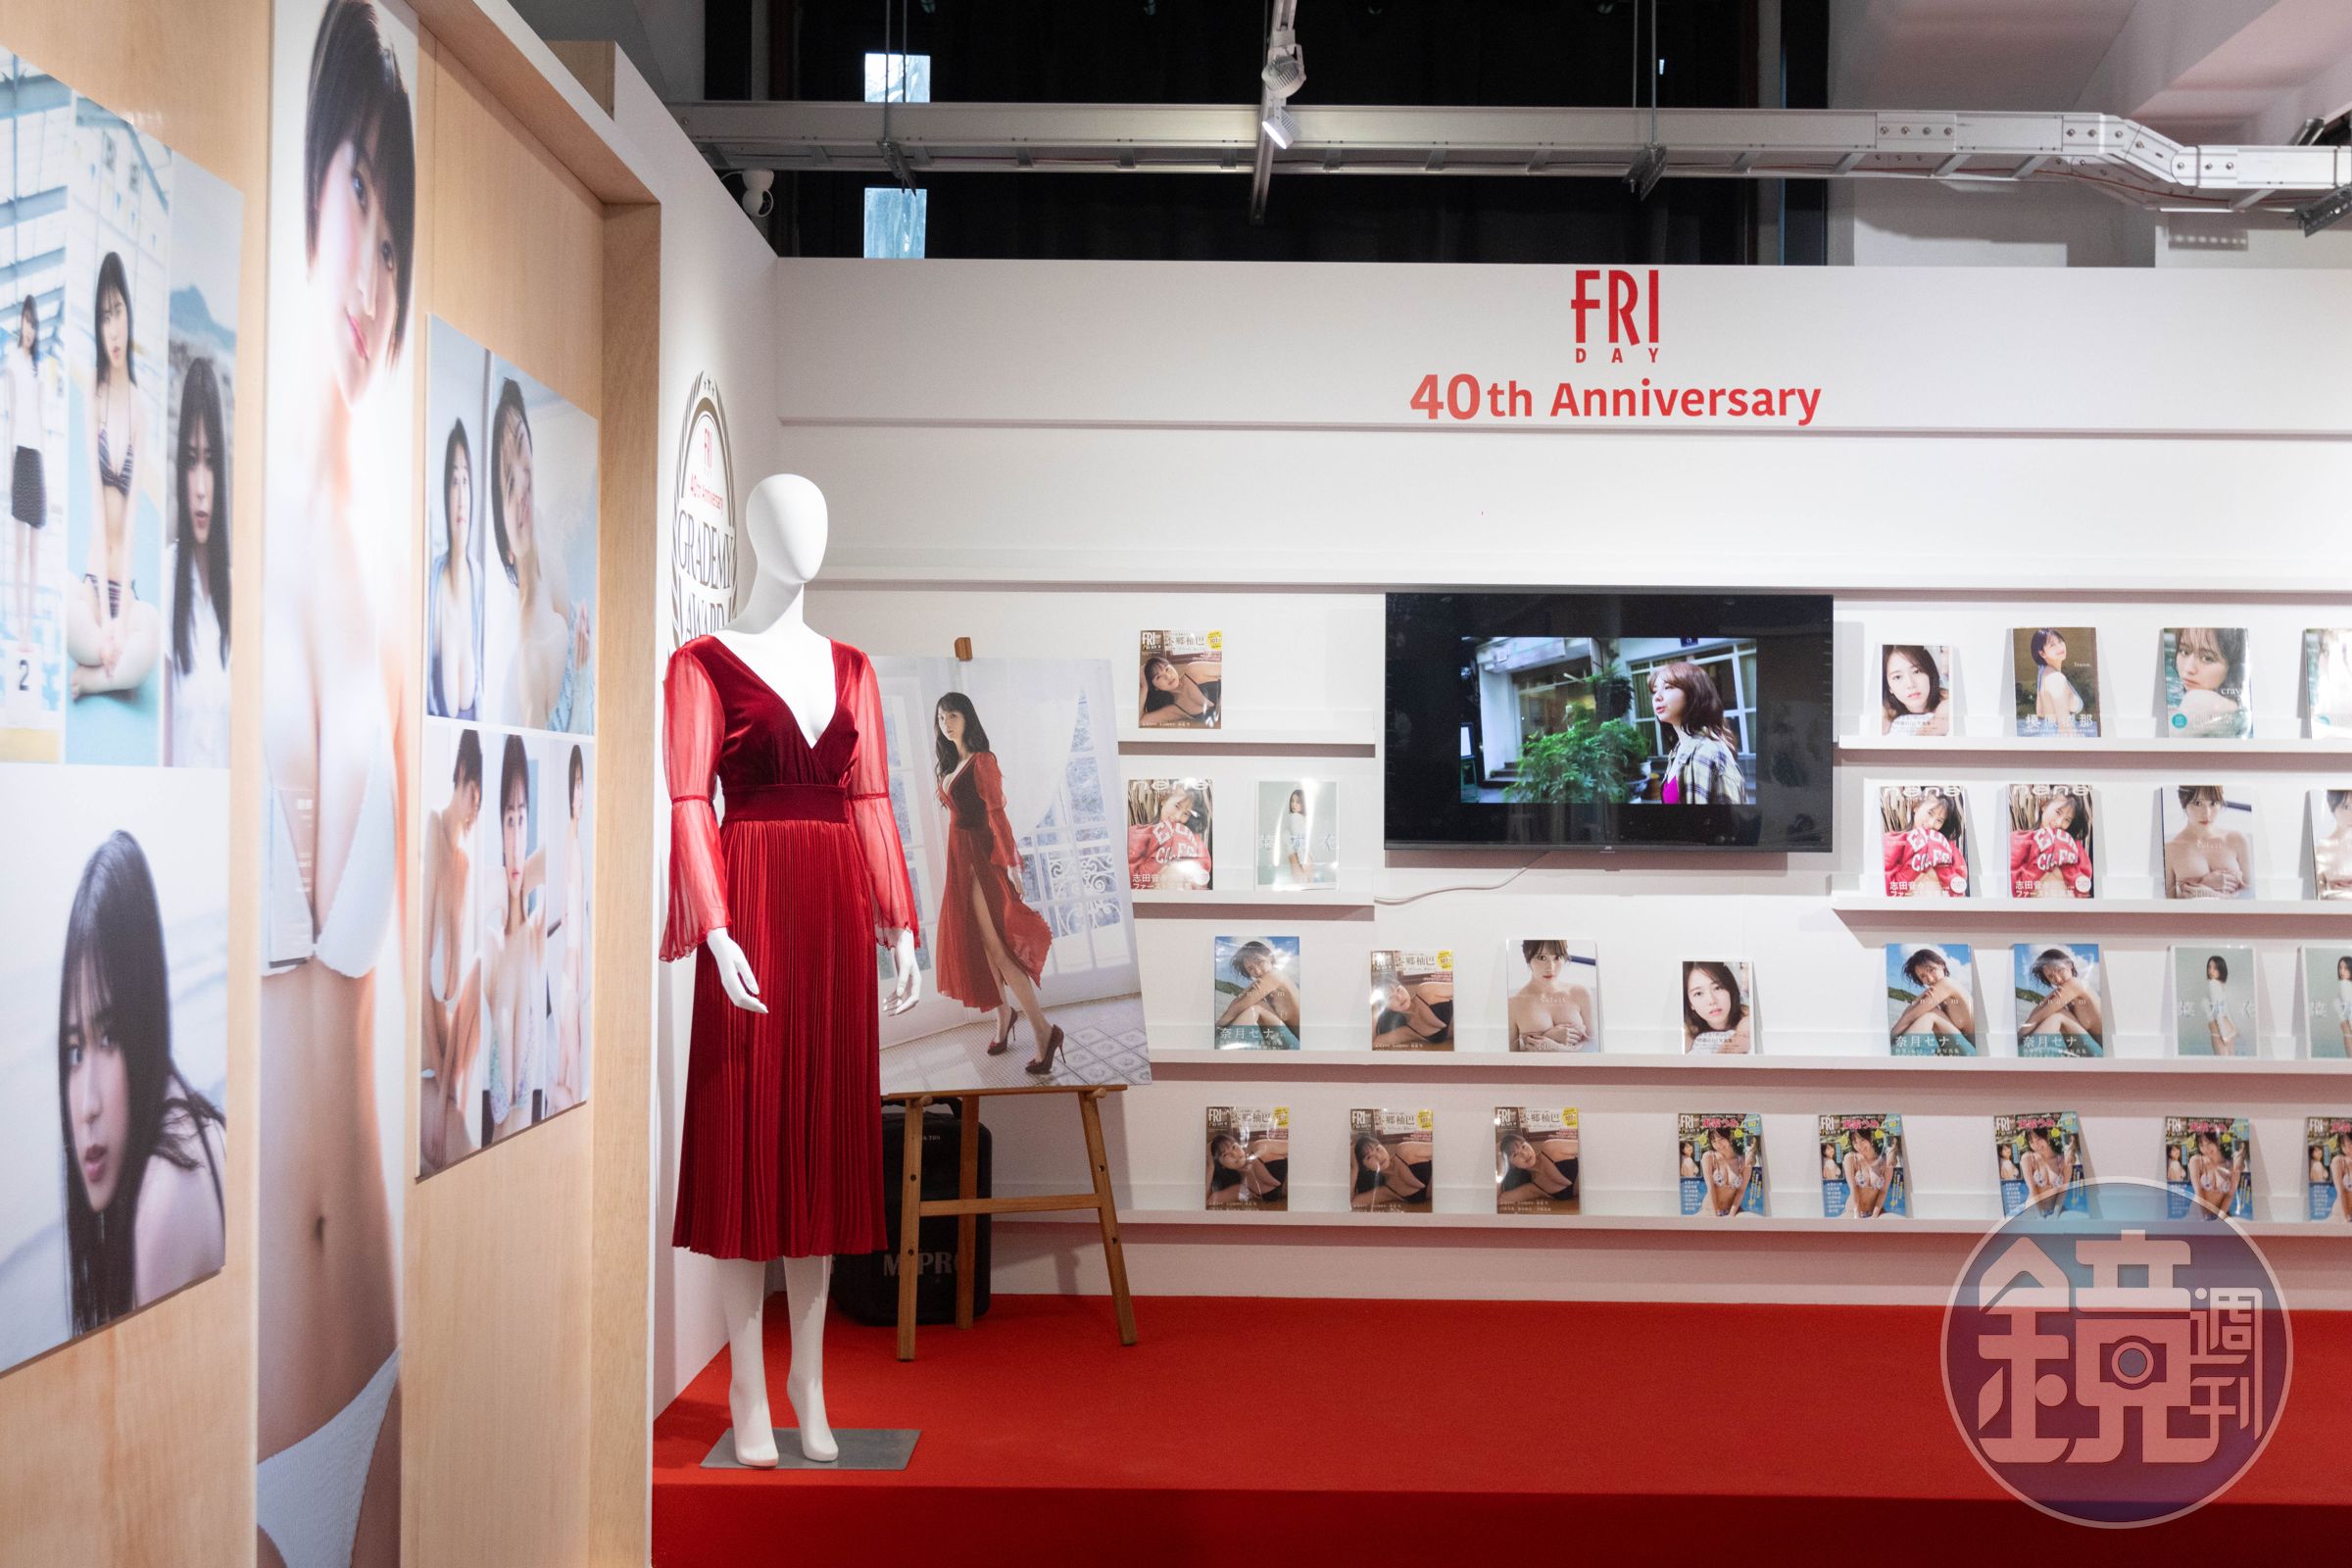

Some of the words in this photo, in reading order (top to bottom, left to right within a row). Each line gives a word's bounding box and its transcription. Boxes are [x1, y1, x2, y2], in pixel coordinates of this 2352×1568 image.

[1571, 270, 1659, 346] FRI
[1576, 348, 1658, 364] DAY
[1409, 373, 1533, 420] 40th
[1550, 377, 1821, 426] Anniversary
[19, 659, 29, 691] 2
[1220, 1027, 1274, 1040] 奈月セナ
[1895, 1035, 1949, 1048] 奈月セナ
[2023, 1036, 2078, 1048] 奈月セナ
[883, 1251, 958, 1277] MPR
